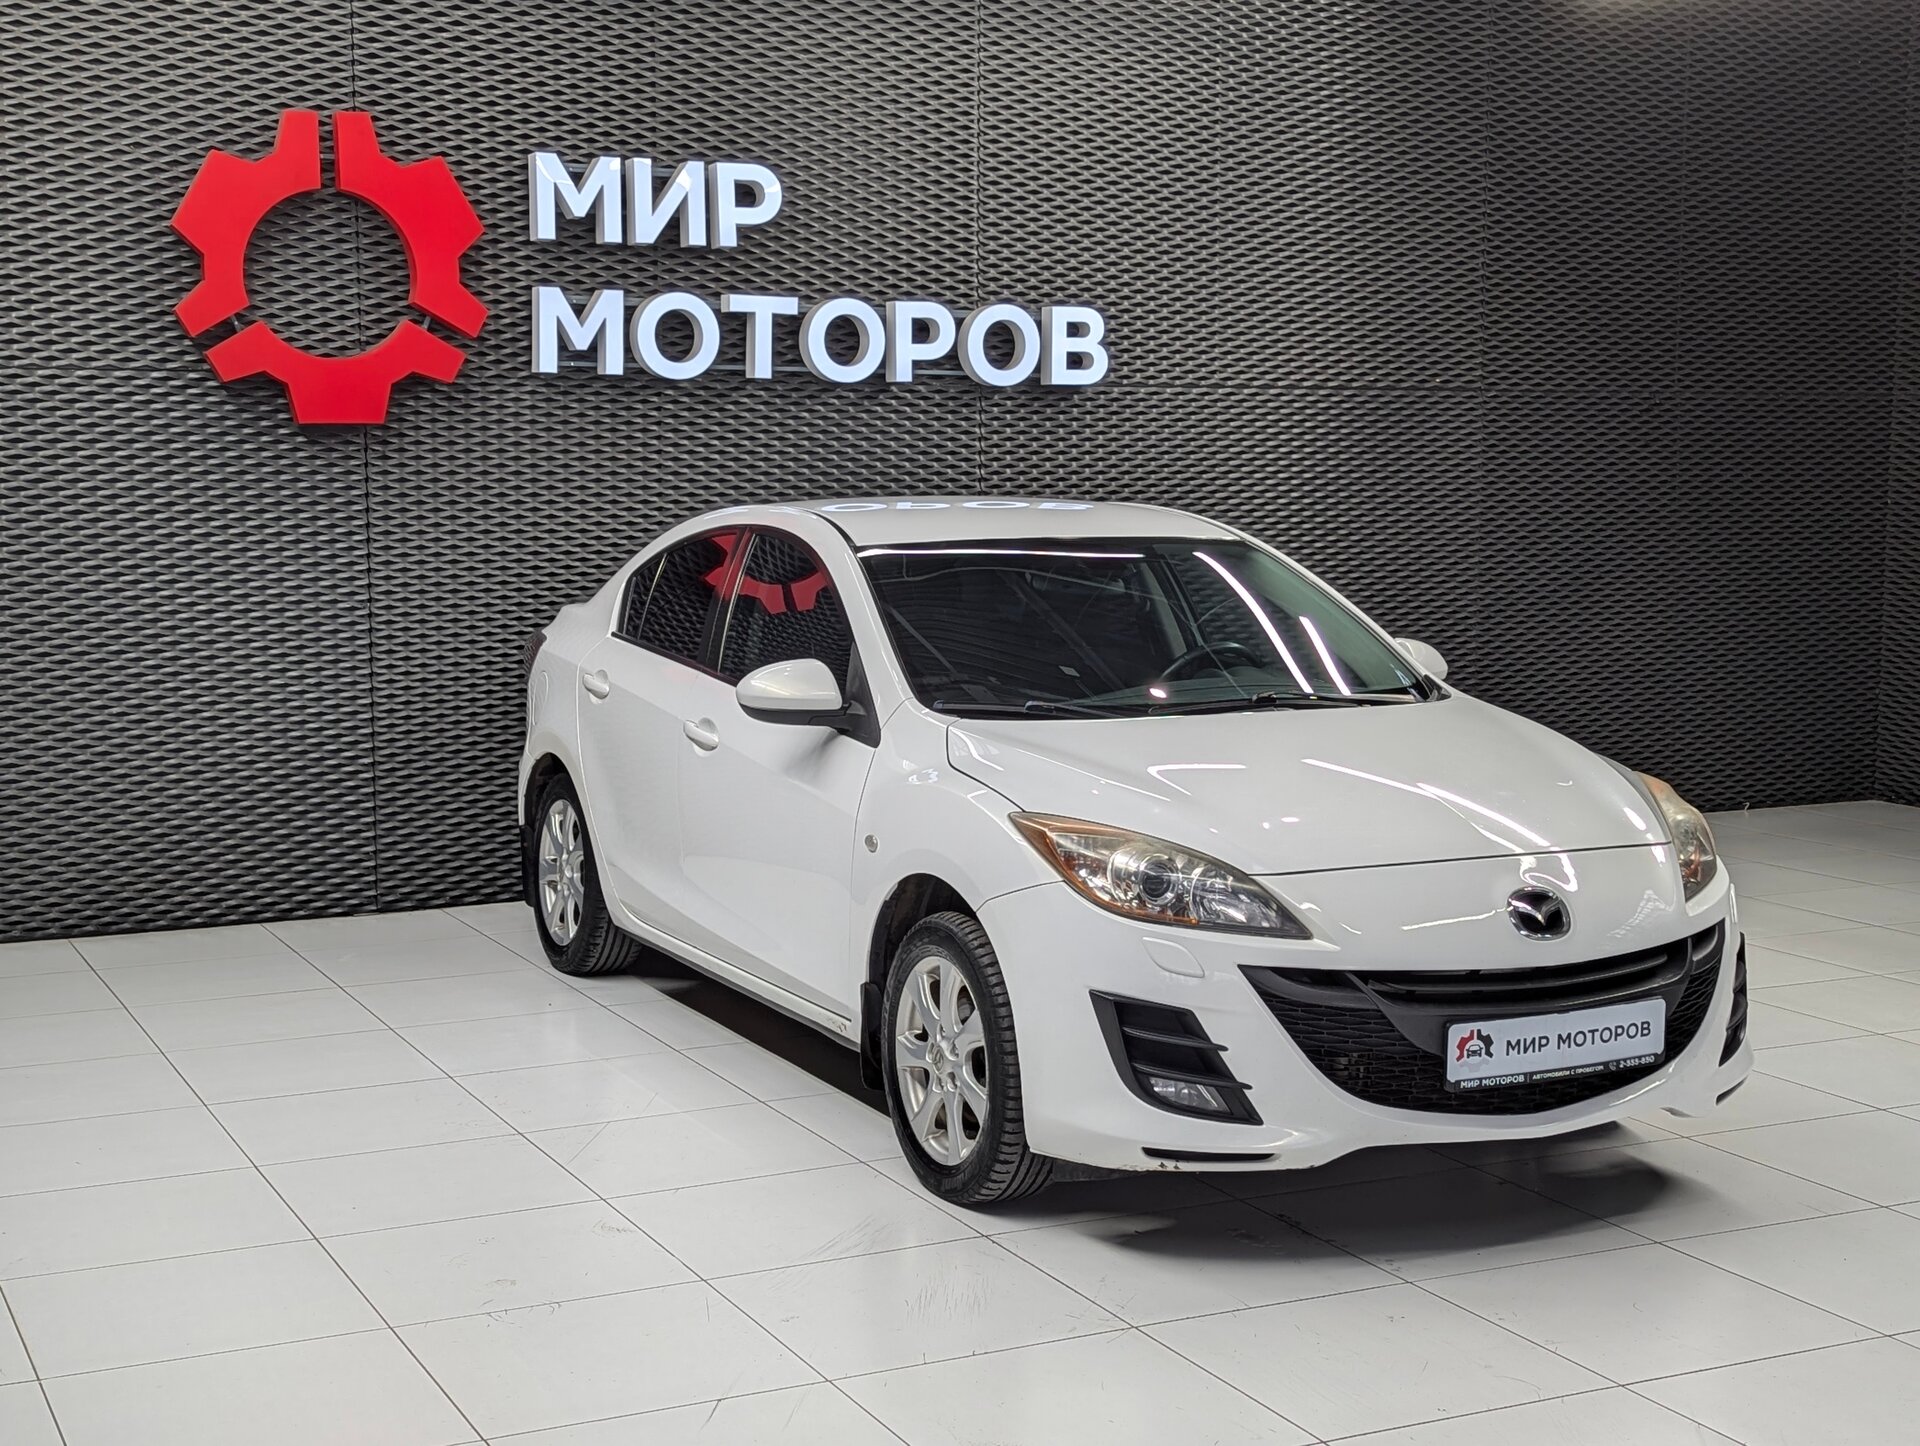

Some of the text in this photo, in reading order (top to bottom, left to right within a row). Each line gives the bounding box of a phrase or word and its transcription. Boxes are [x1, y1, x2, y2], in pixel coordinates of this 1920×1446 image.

[528, 152, 783, 249] МИР
[531, 286, 1109, 387] МОТОРОВ
[1505, 1020, 1651, 1057] МИР МОТОРОВ
[1460, 1080, 1480, 1089] МИР
[1481, 1074, 1525, 1087] МОТОРОВ
[1532, 1070, 1570, 1080] АВТОМОБИЛИ
[1575, 1065, 1604, 1074] ПРОБЕГОМ
